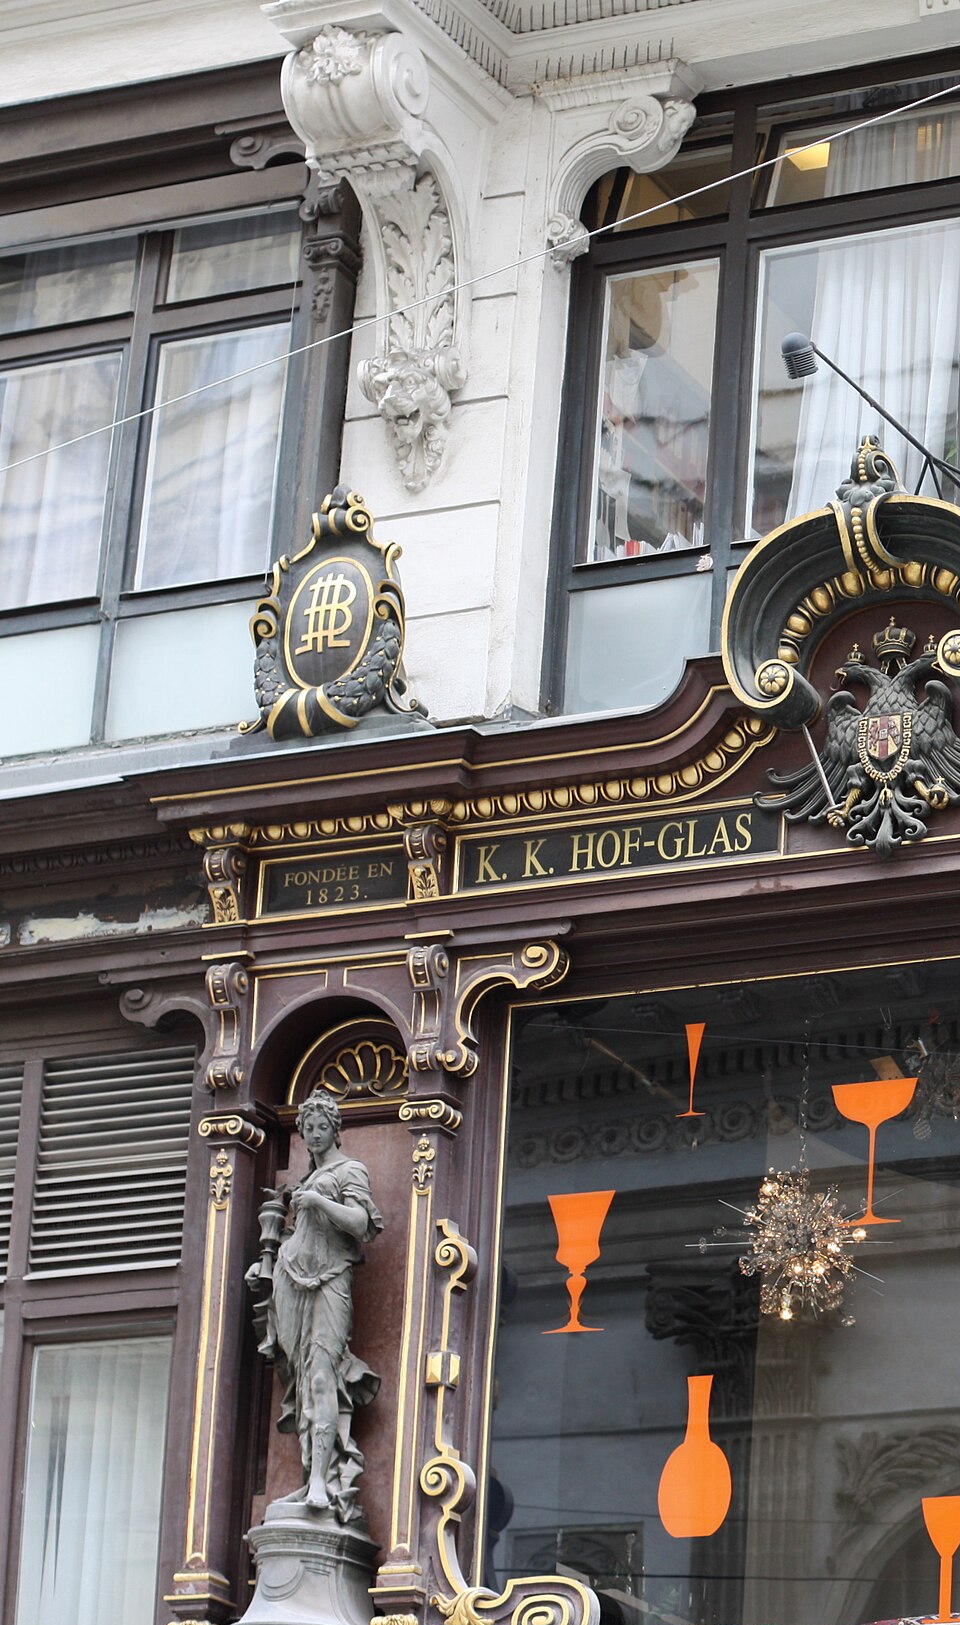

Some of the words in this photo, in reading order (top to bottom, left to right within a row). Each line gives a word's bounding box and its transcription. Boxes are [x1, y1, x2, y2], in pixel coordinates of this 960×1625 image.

[475, 844, 507, 884] K.
[521, 838, 554, 878] K.
[568, 813, 752, 872] HOF-GLAS
[283, 863, 360, 888] FONDÉE
[367, 862, 394, 879] EN
[305, 884, 368, 905] 1823.
